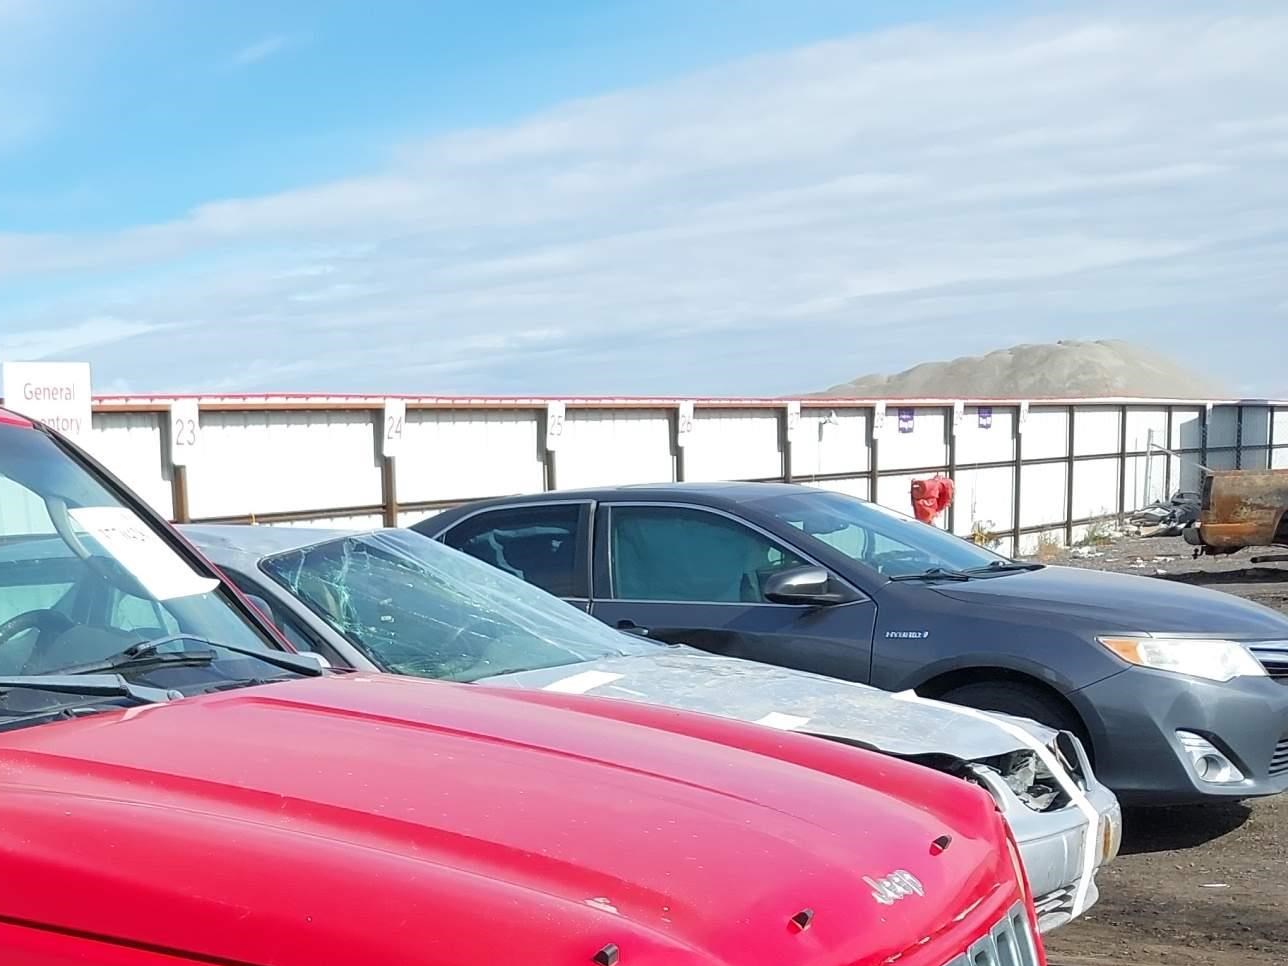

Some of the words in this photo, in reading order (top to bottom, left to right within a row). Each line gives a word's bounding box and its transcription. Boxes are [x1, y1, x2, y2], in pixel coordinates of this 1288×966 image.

[23, 382, 76, 401] General
[175, 418, 196, 446] 23
[387, 415, 403, 440] 24
[549, 414, 563, 437] 25
[861, 869, 926, 906] Jeep
